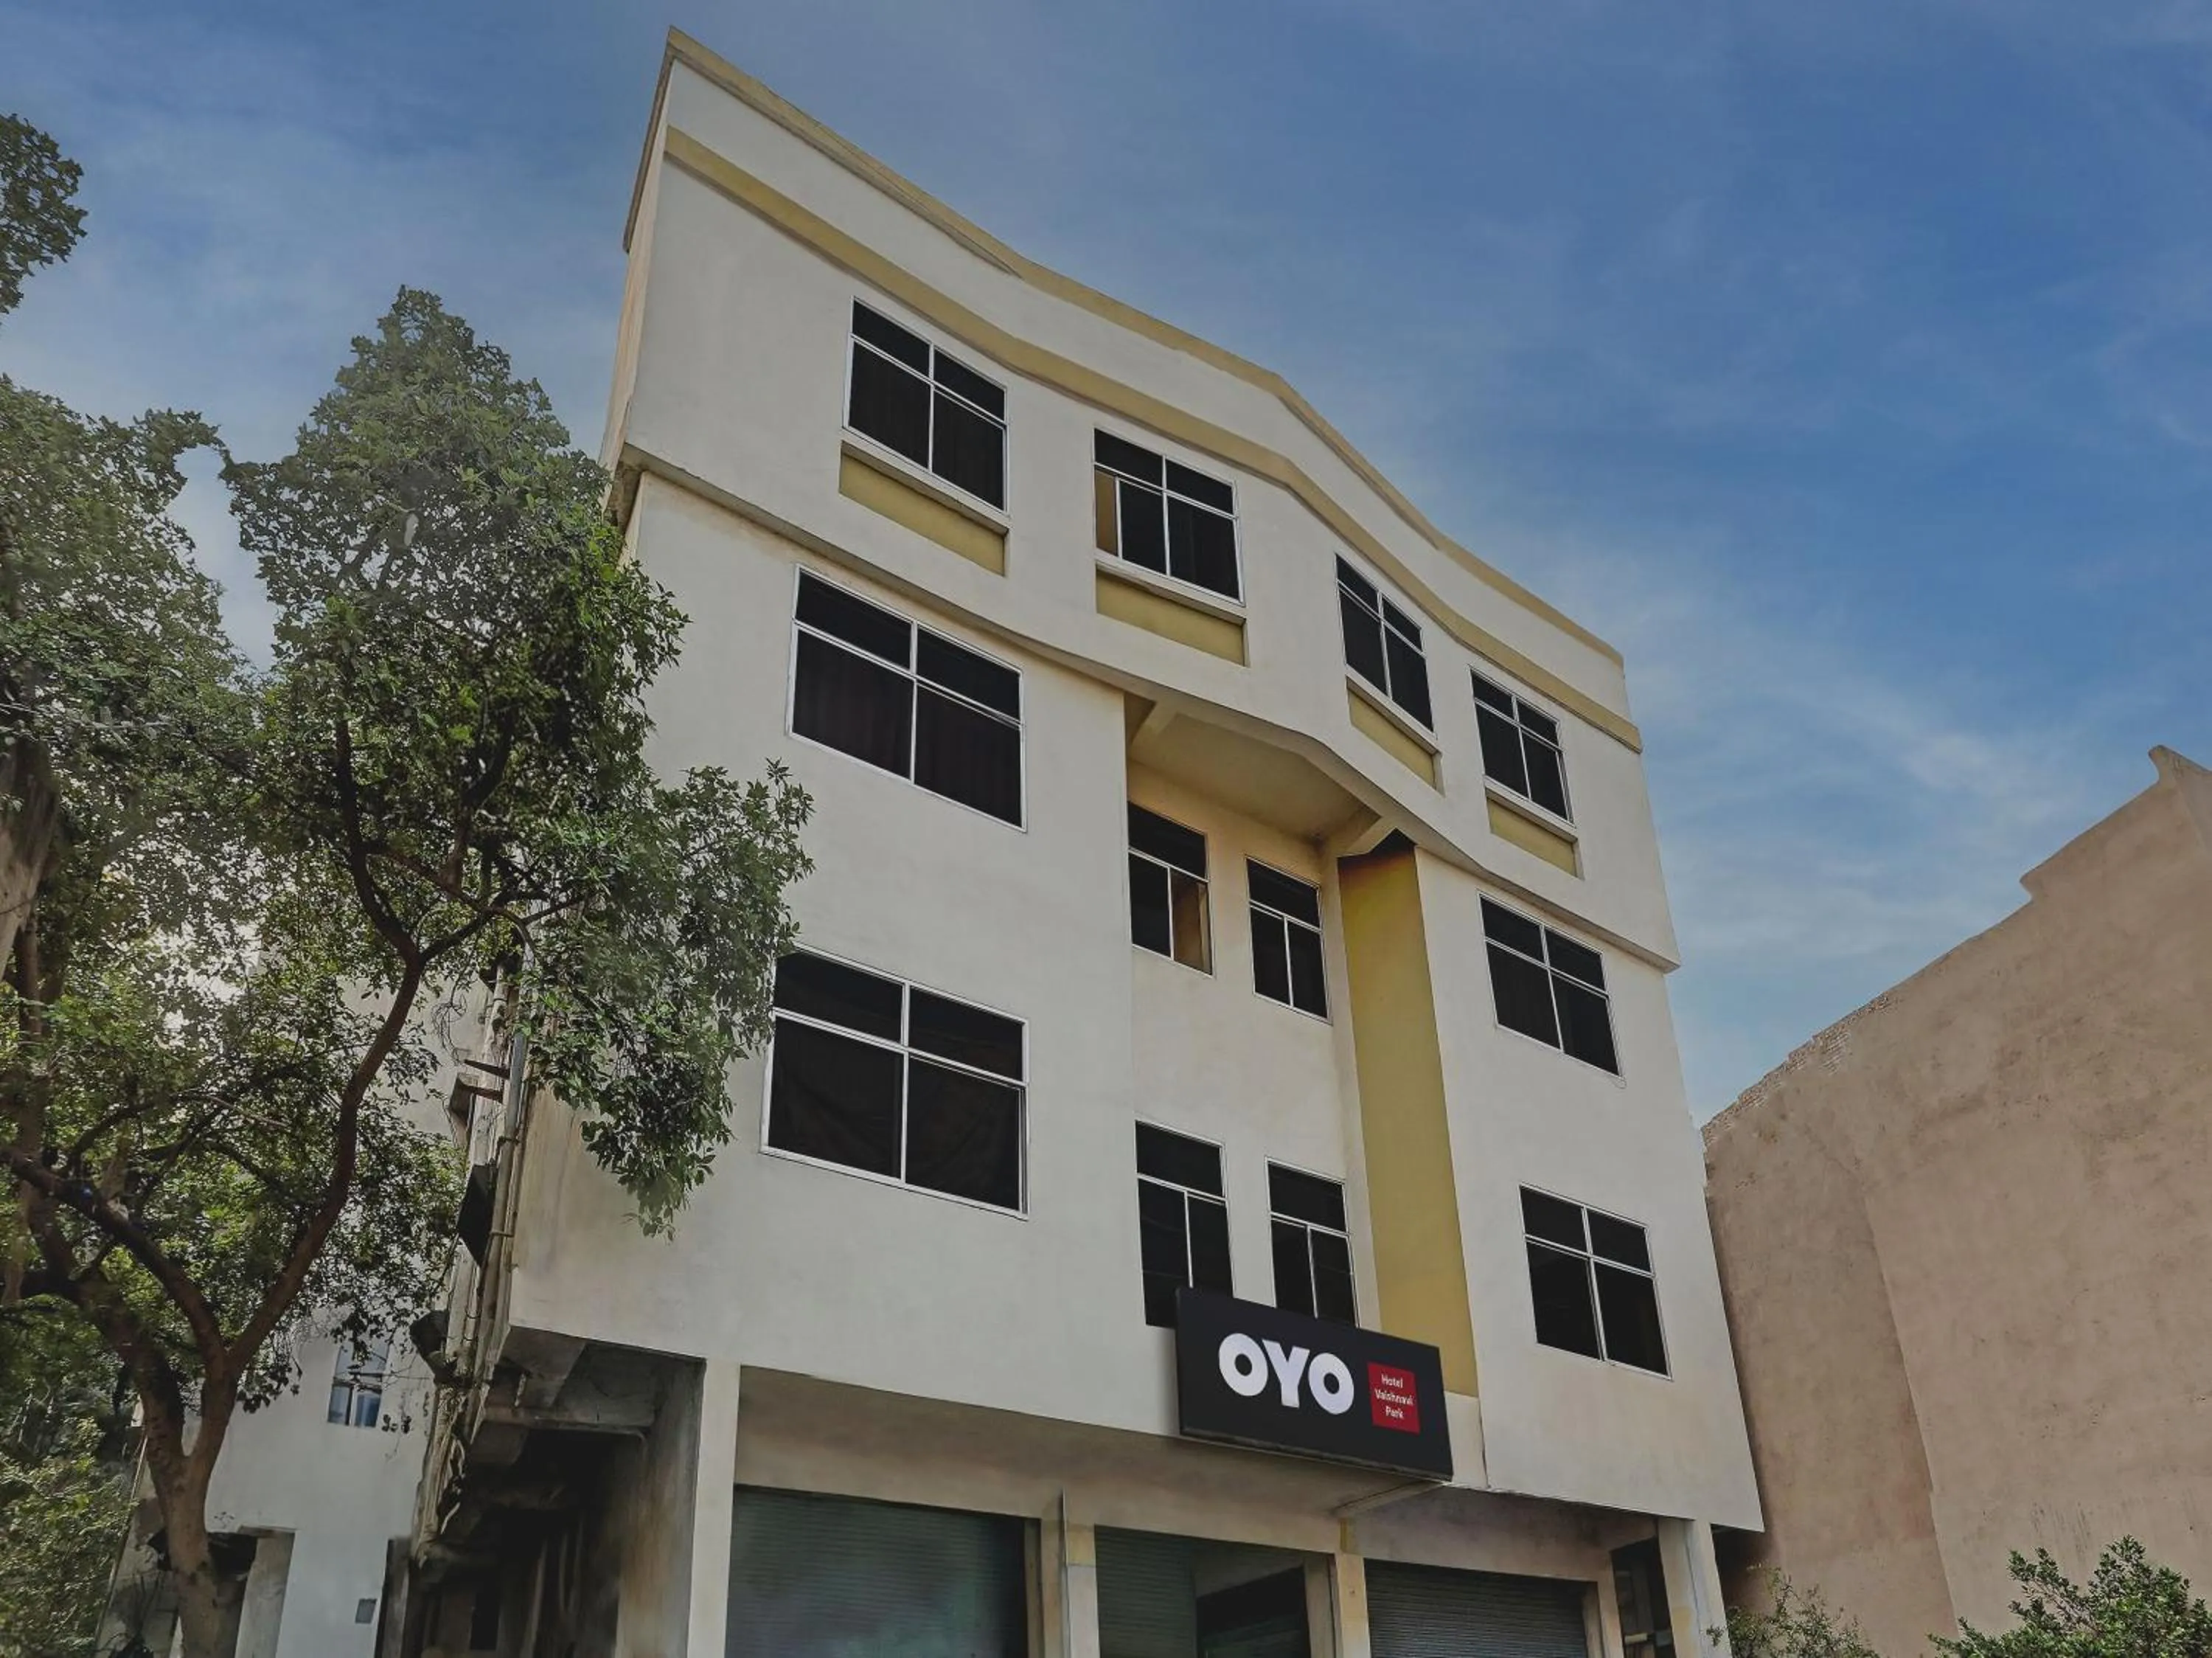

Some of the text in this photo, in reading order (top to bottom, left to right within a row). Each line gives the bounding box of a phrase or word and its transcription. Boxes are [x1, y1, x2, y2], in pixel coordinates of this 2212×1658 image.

[1218, 1333, 1354, 1415] OYO
[1381, 1374, 1403, 1389] Hotel
[1374, 1388, 1413, 1406] Vaishnavi
[1385, 1405, 1405, 1419] Park
